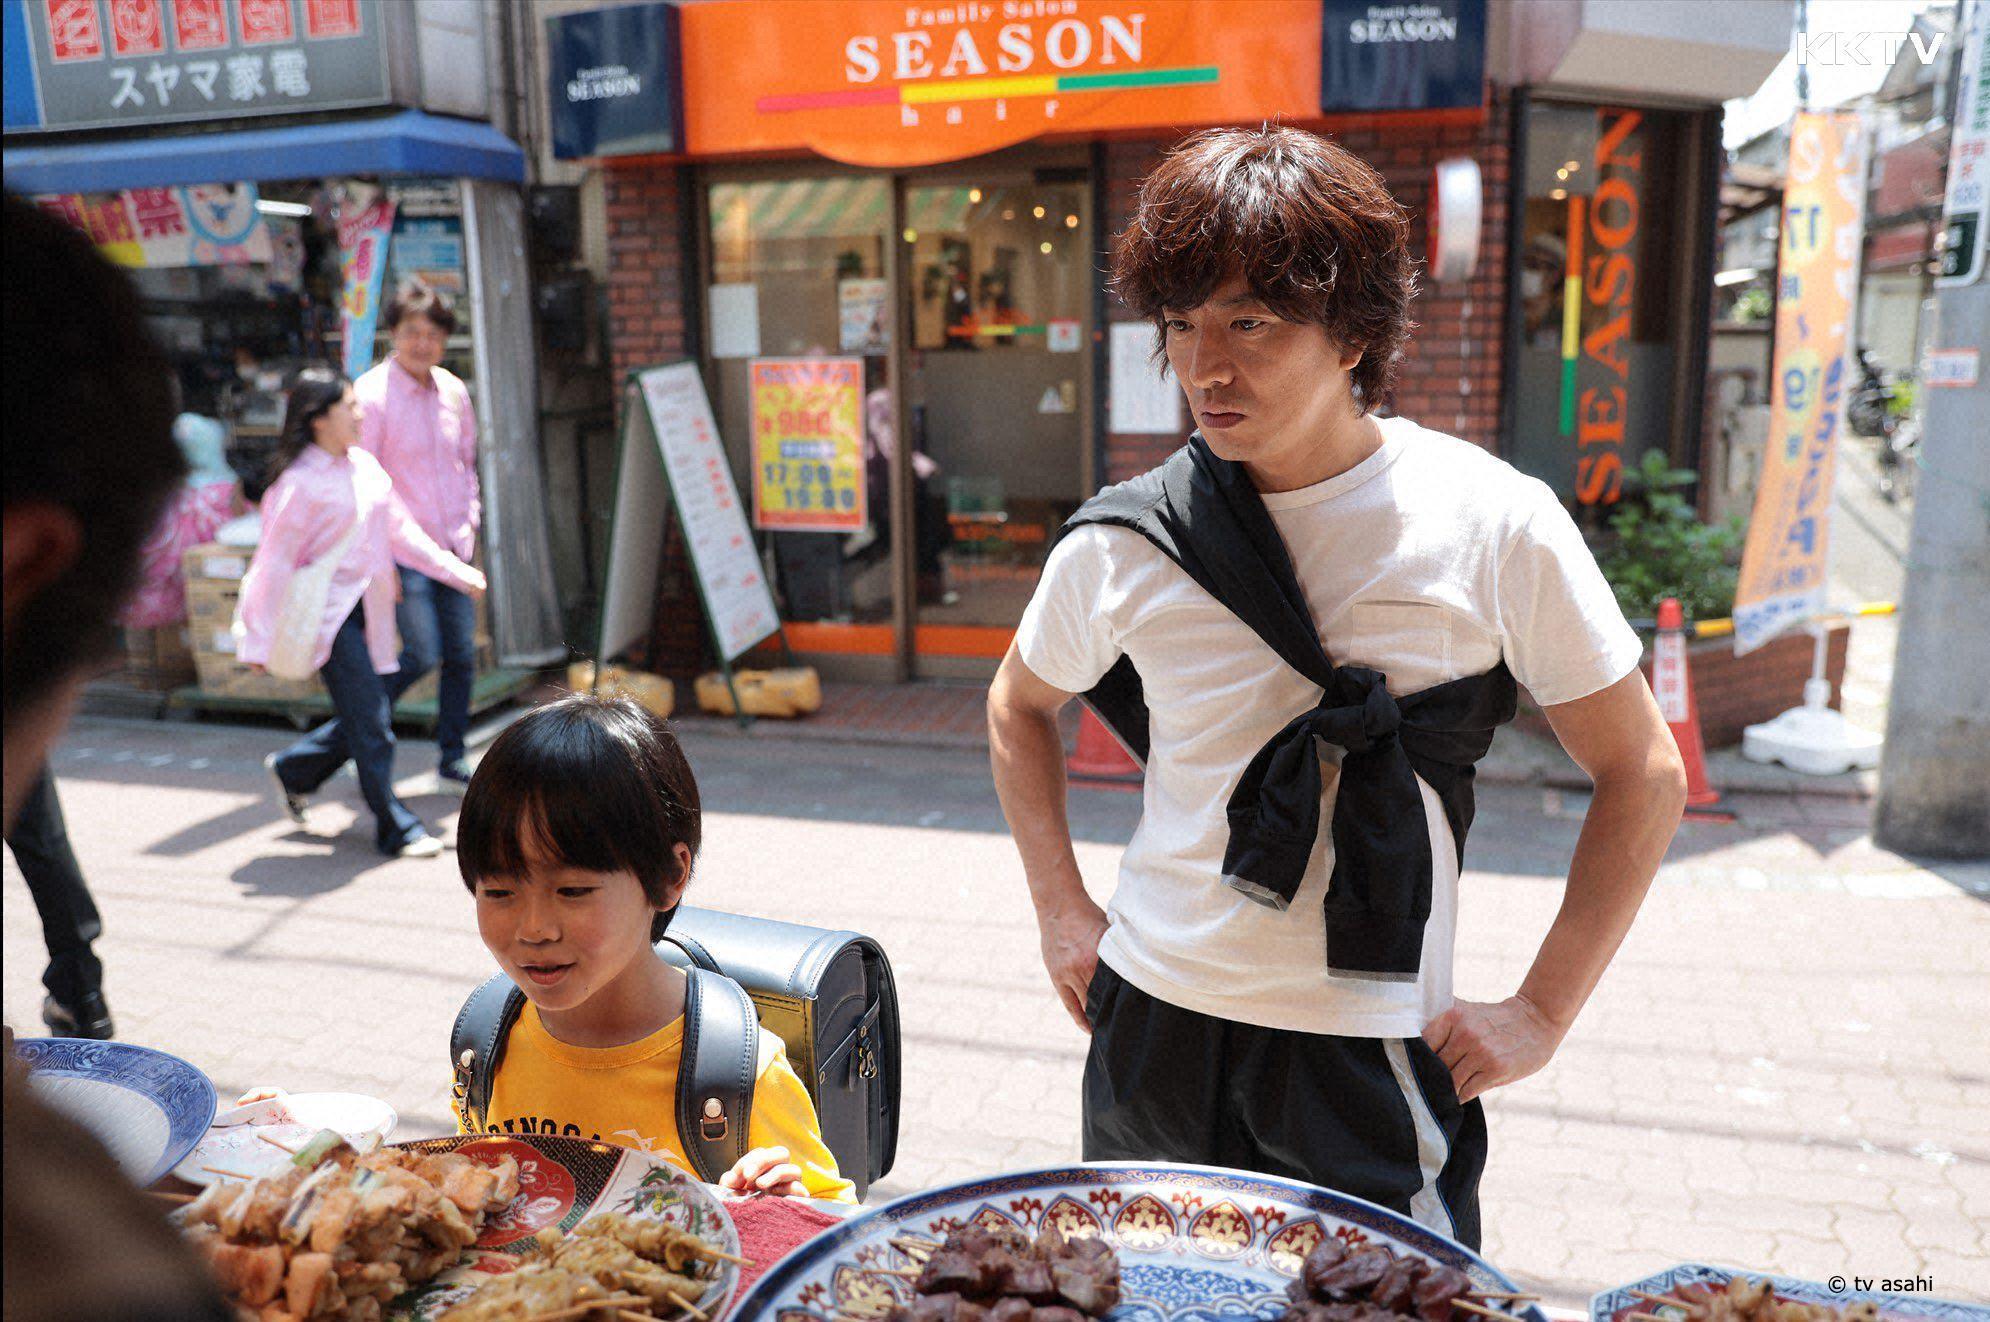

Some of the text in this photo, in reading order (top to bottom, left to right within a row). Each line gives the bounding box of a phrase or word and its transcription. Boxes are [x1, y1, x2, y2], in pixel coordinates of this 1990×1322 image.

[904, 0, 1078, 27] Family Salon
[1349, 17, 1458, 43] SEASON
[109, 48, 312, 109] スヤマ家電
[845, 13, 1147, 83] SEASON
[1575, 106, 1643, 505] SEASON
